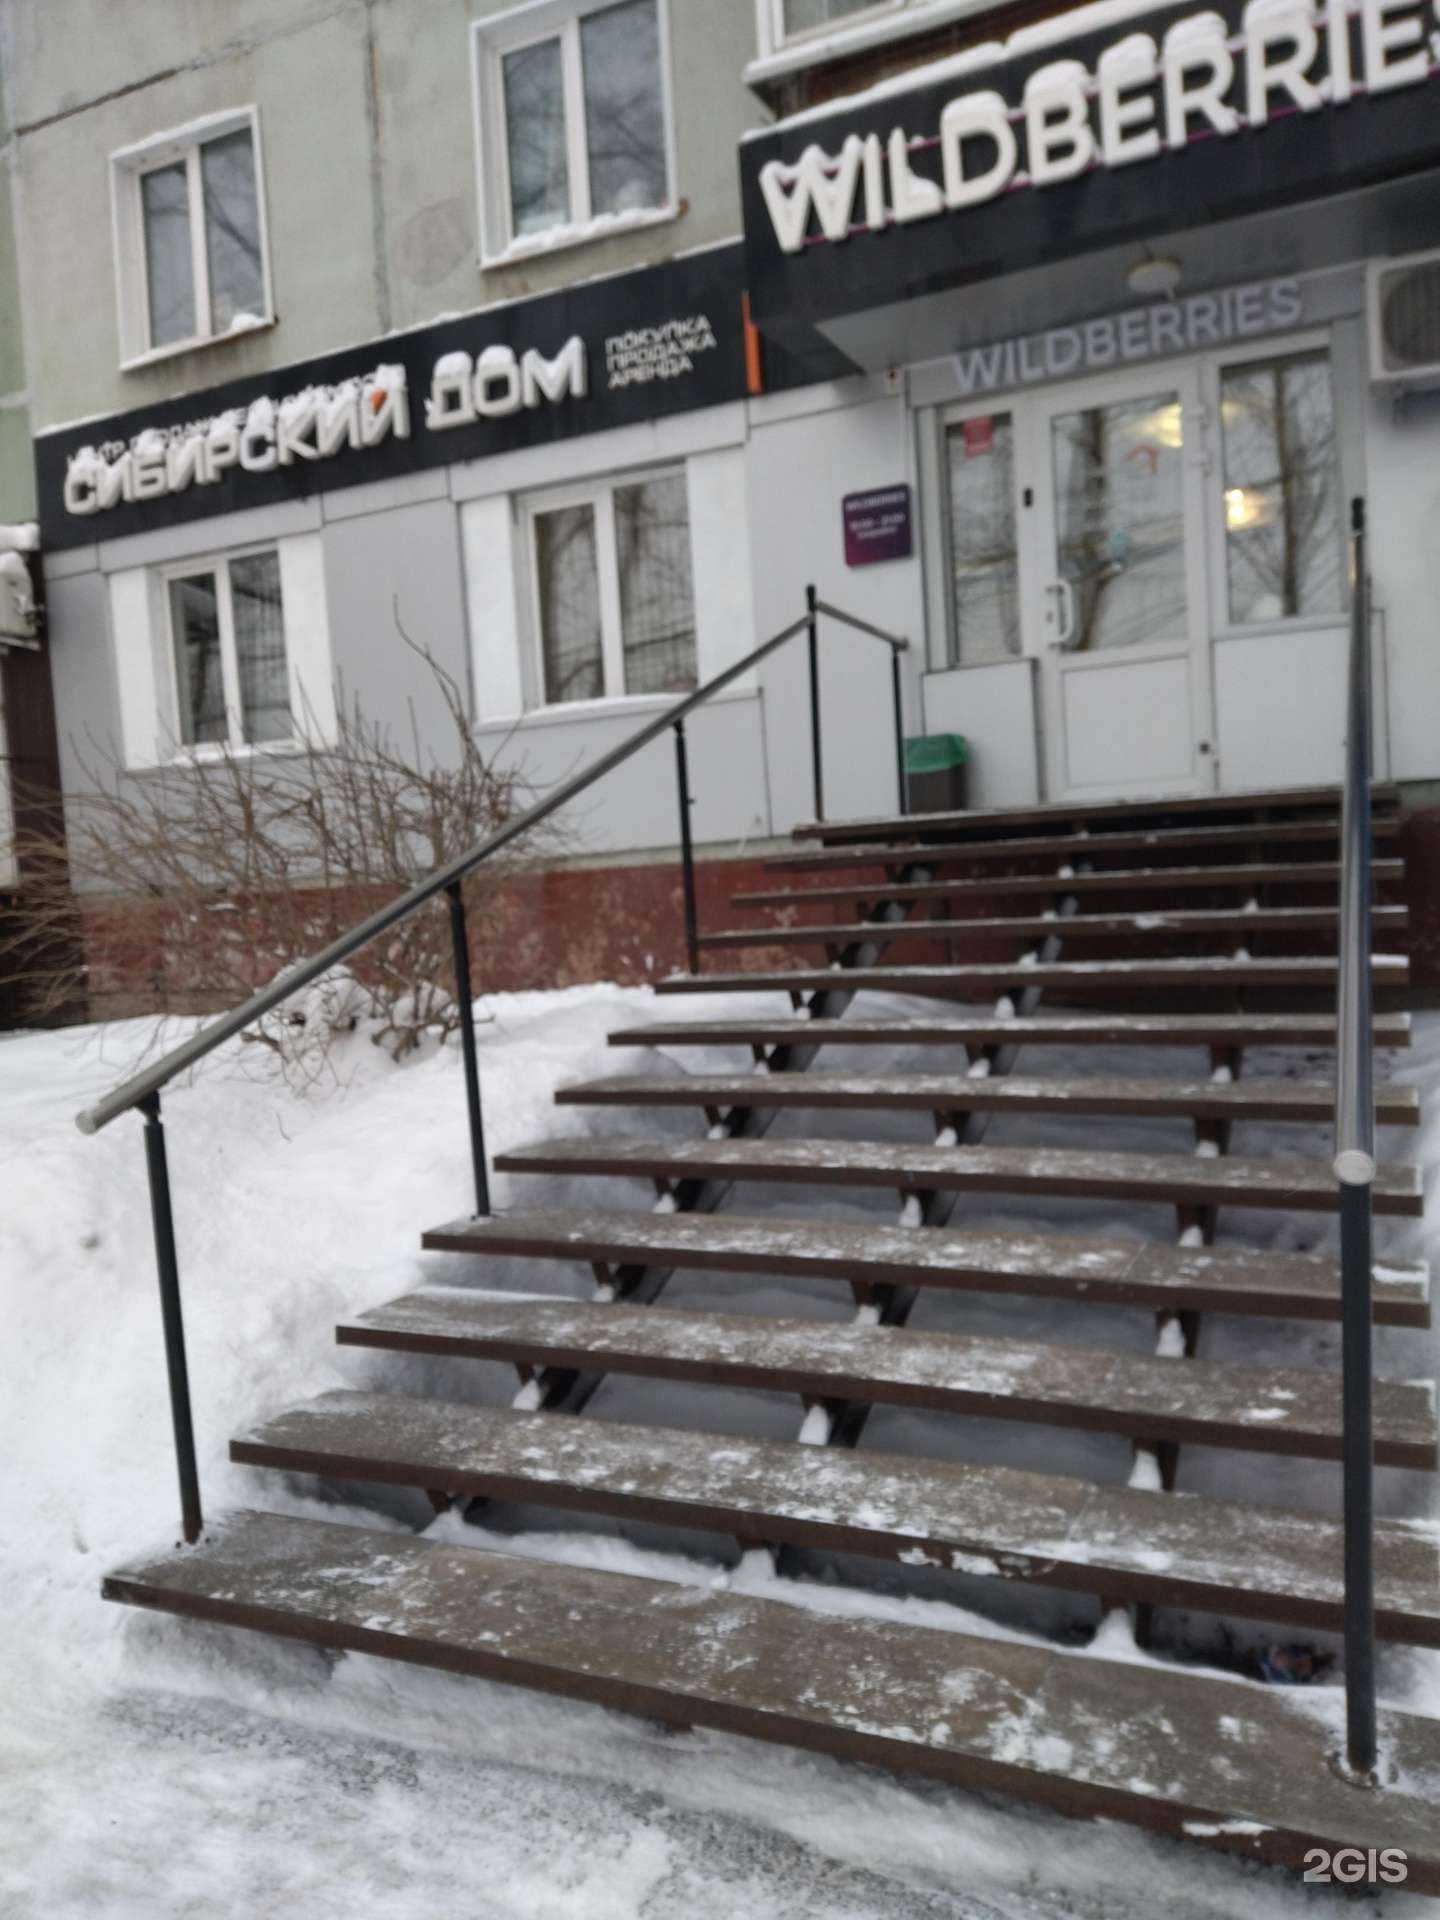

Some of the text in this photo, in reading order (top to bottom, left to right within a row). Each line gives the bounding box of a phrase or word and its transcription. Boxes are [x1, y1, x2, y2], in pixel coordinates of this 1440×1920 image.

[759, 0, 1440, 252] WILDBERRIE
[605, 315, 711, 355] ПОКУПКА
[606, 333, 717, 372] ПРОДАЖА
[608, 354, 693, 390] АРЕНДА
[953, 279, 1301, 392] WILDBERRIES
[64, 363, 411, 515] СИБИРСКИЙ
[424, 335, 587, 430] ДОМ
